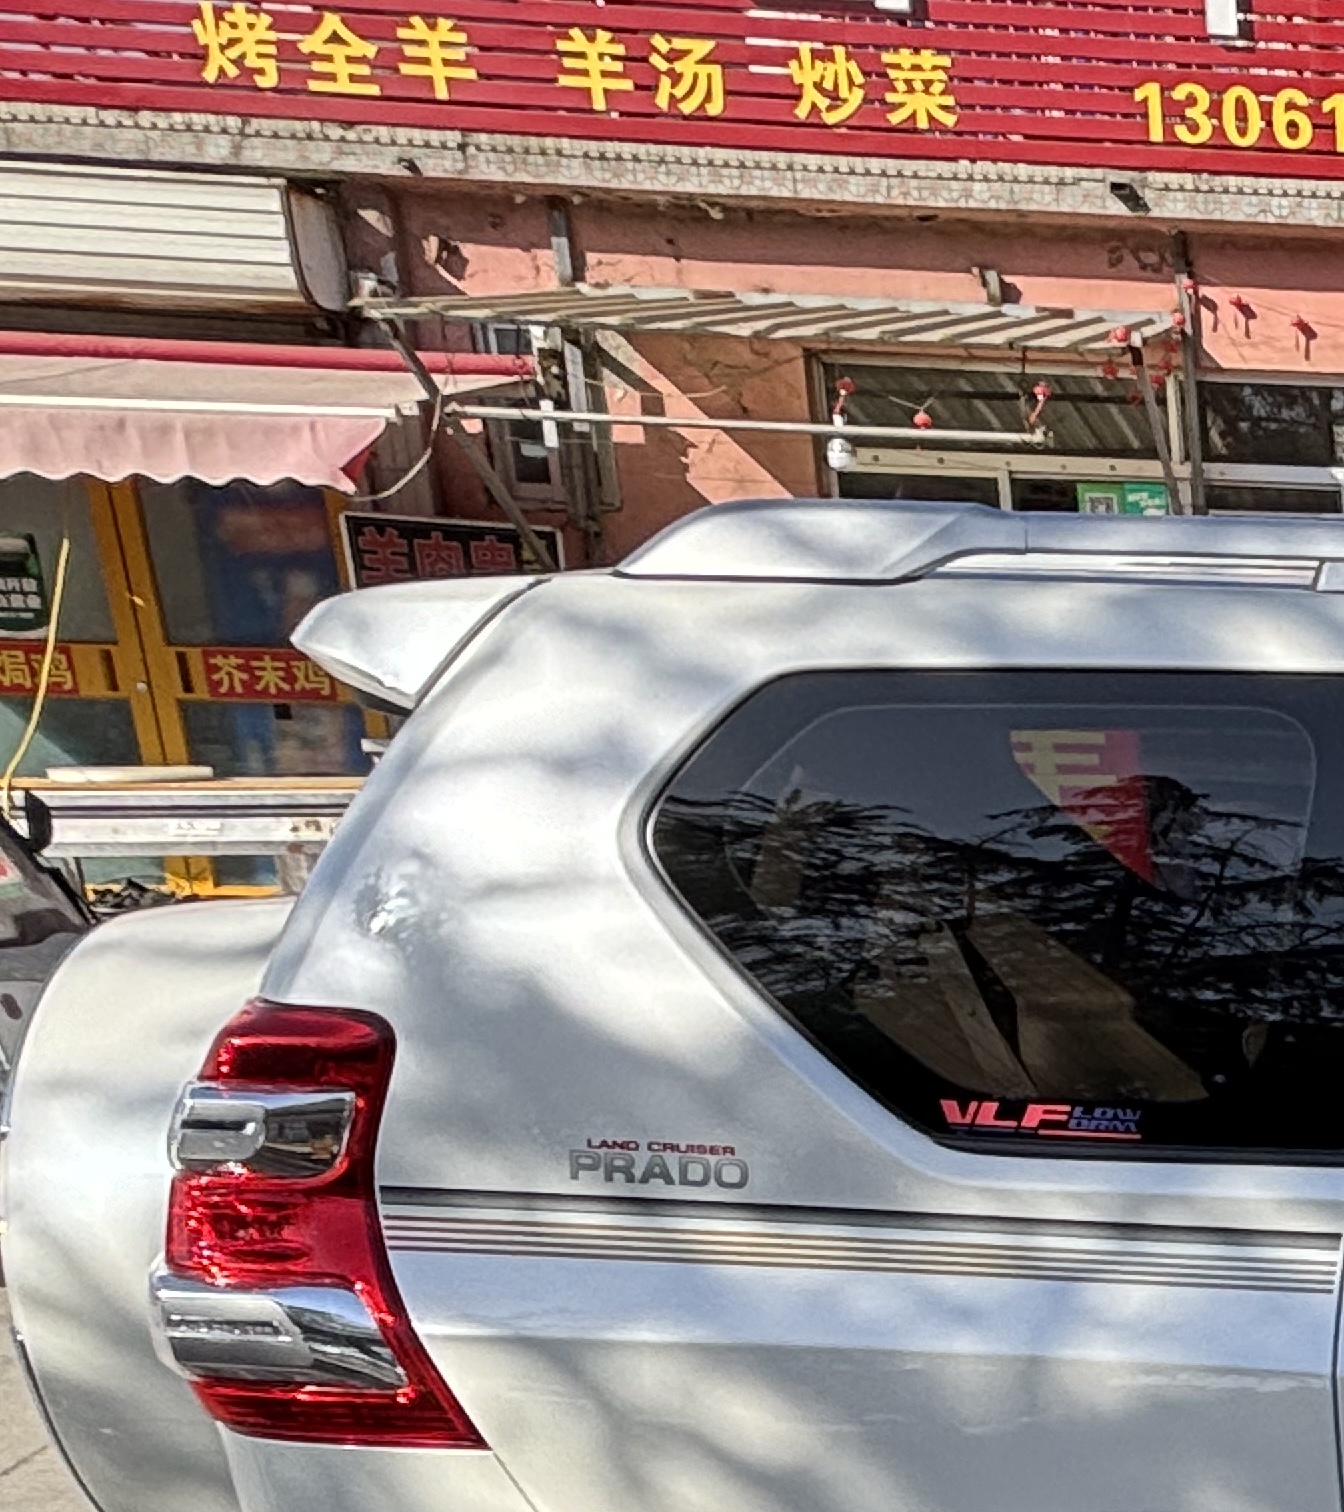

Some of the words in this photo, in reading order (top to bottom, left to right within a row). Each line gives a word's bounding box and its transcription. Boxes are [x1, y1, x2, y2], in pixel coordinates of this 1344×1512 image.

[192, 3, 478, 100] 烤全羊
[556, 28, 728, 117] 羊汤
[791, 45, 960, 130] 炒菜
[208, 654, 332, 697] 芥末鸡
[587, 1137, 640, 1152] LAND
[647, 1140, 736, 1157] CRUISER
[569, 1149, 750, 1190] PRADO
